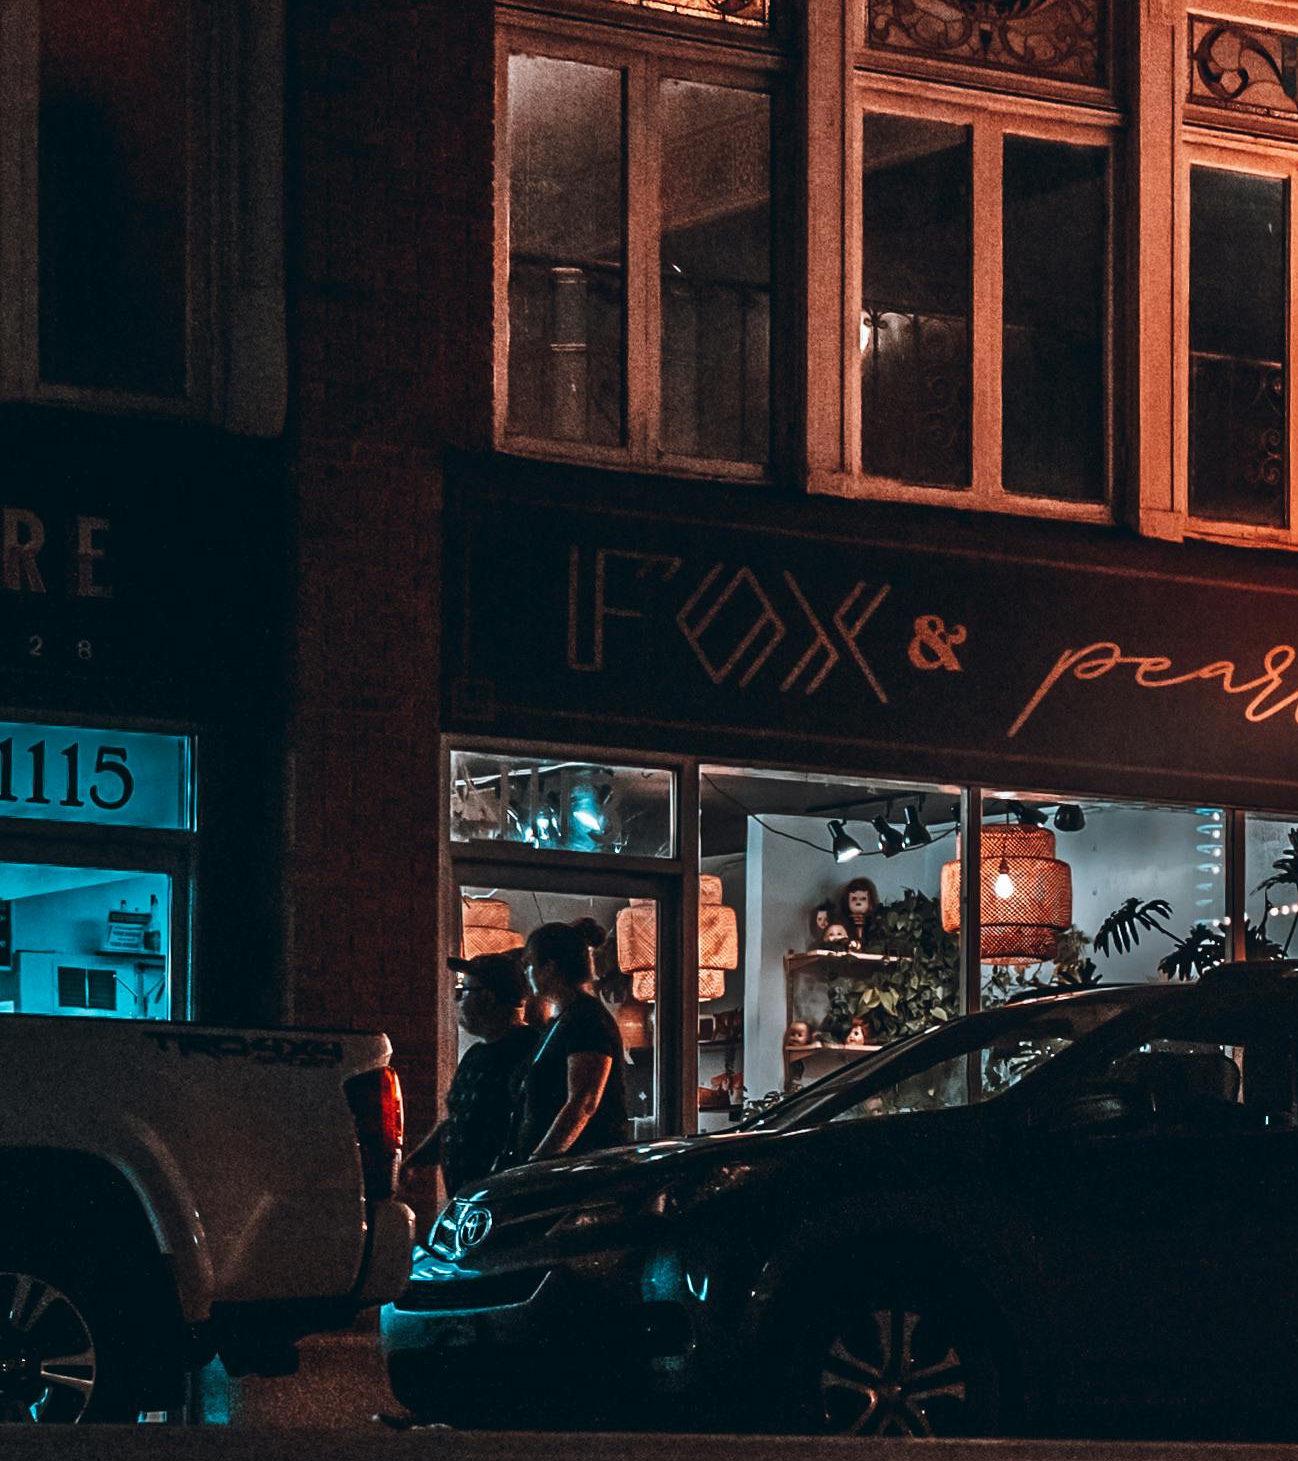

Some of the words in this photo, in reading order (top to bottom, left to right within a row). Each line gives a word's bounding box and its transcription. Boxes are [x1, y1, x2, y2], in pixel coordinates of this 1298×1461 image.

[567, 545, 893, 704] FOX
[907, 613, 967, 673] &
[0, 738, 134, 810] 1115
